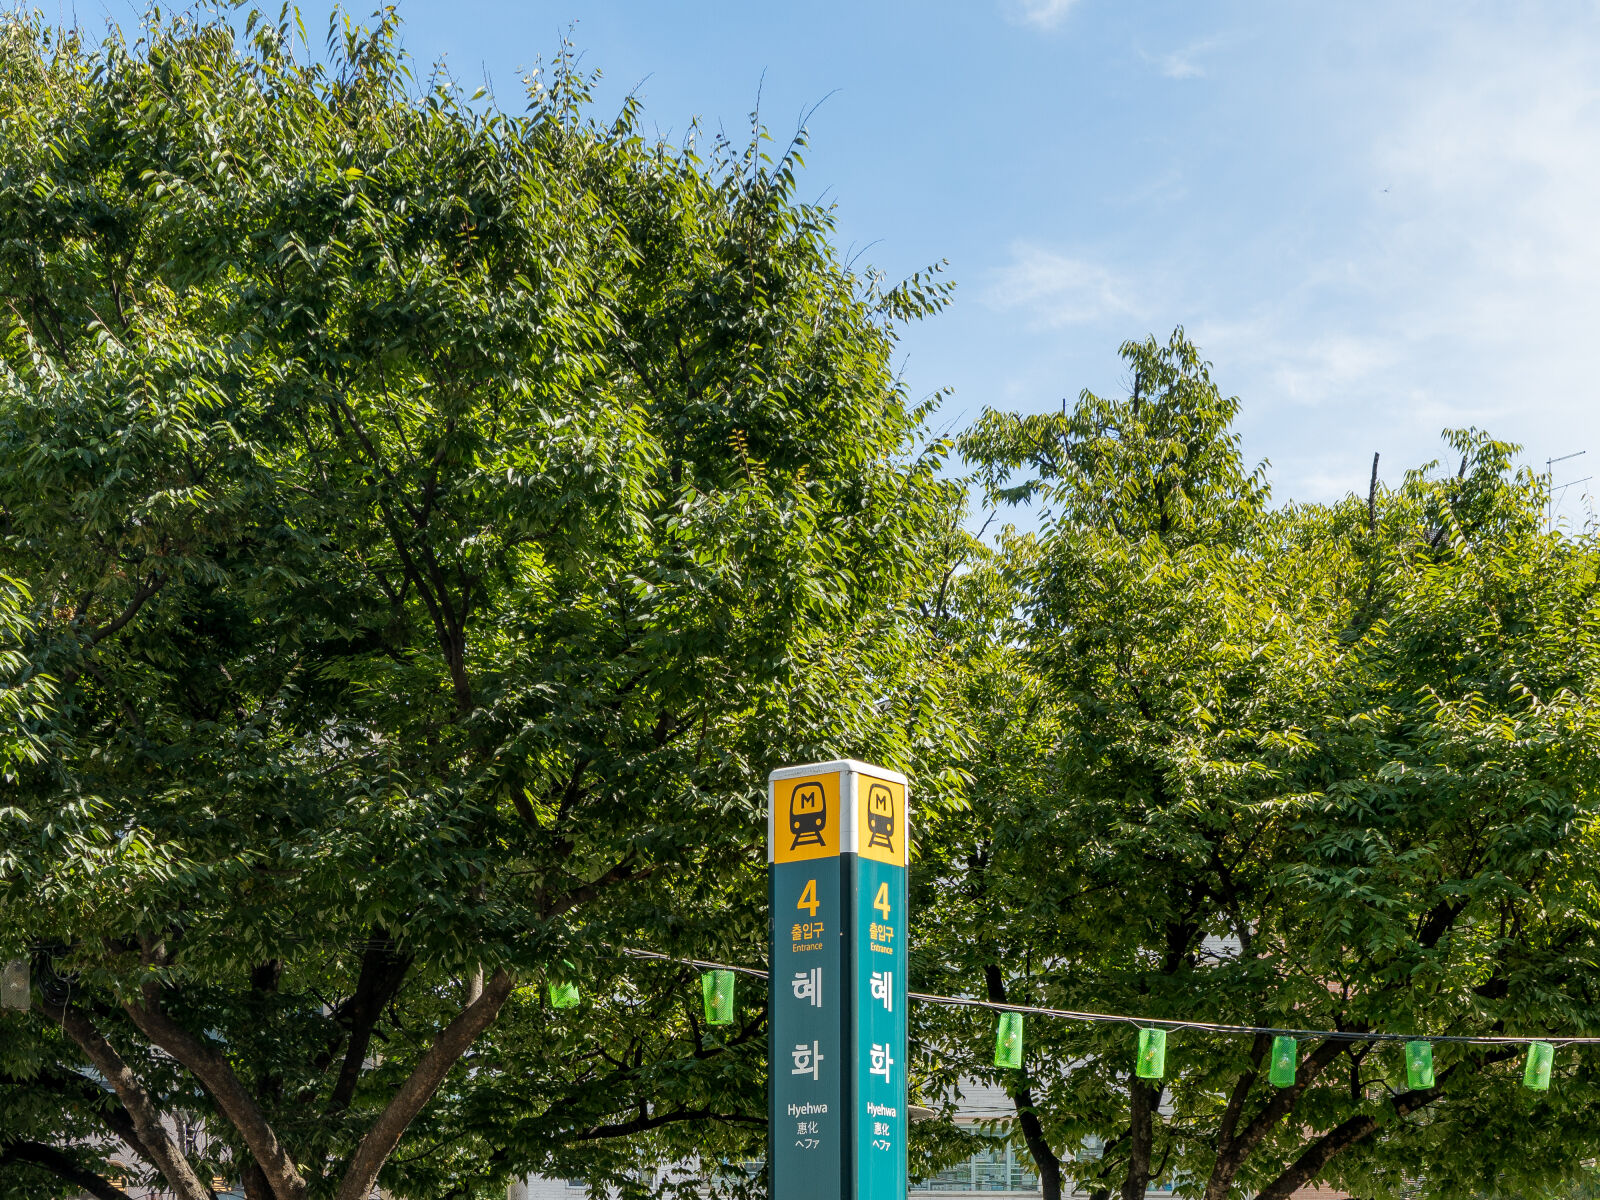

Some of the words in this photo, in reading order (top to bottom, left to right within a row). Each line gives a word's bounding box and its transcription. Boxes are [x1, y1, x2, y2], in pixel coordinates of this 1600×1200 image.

[797, 879, 820, 917] 4
[873, 882, 891, 921] 4
[791, 922, 824, 942] 출입구
[869, 922, 894, 944] 출입구
[792, 942, 823, 953] Entrance
[870, 942, 893, 955] Entrance
[791, 967, 824, 1081] 혜화
[869, 971, 894, 1084] 혜화
[787, 1102, 828, 1118] Hyehwa
[867, 1101, 897, 1118] Hyehwa
